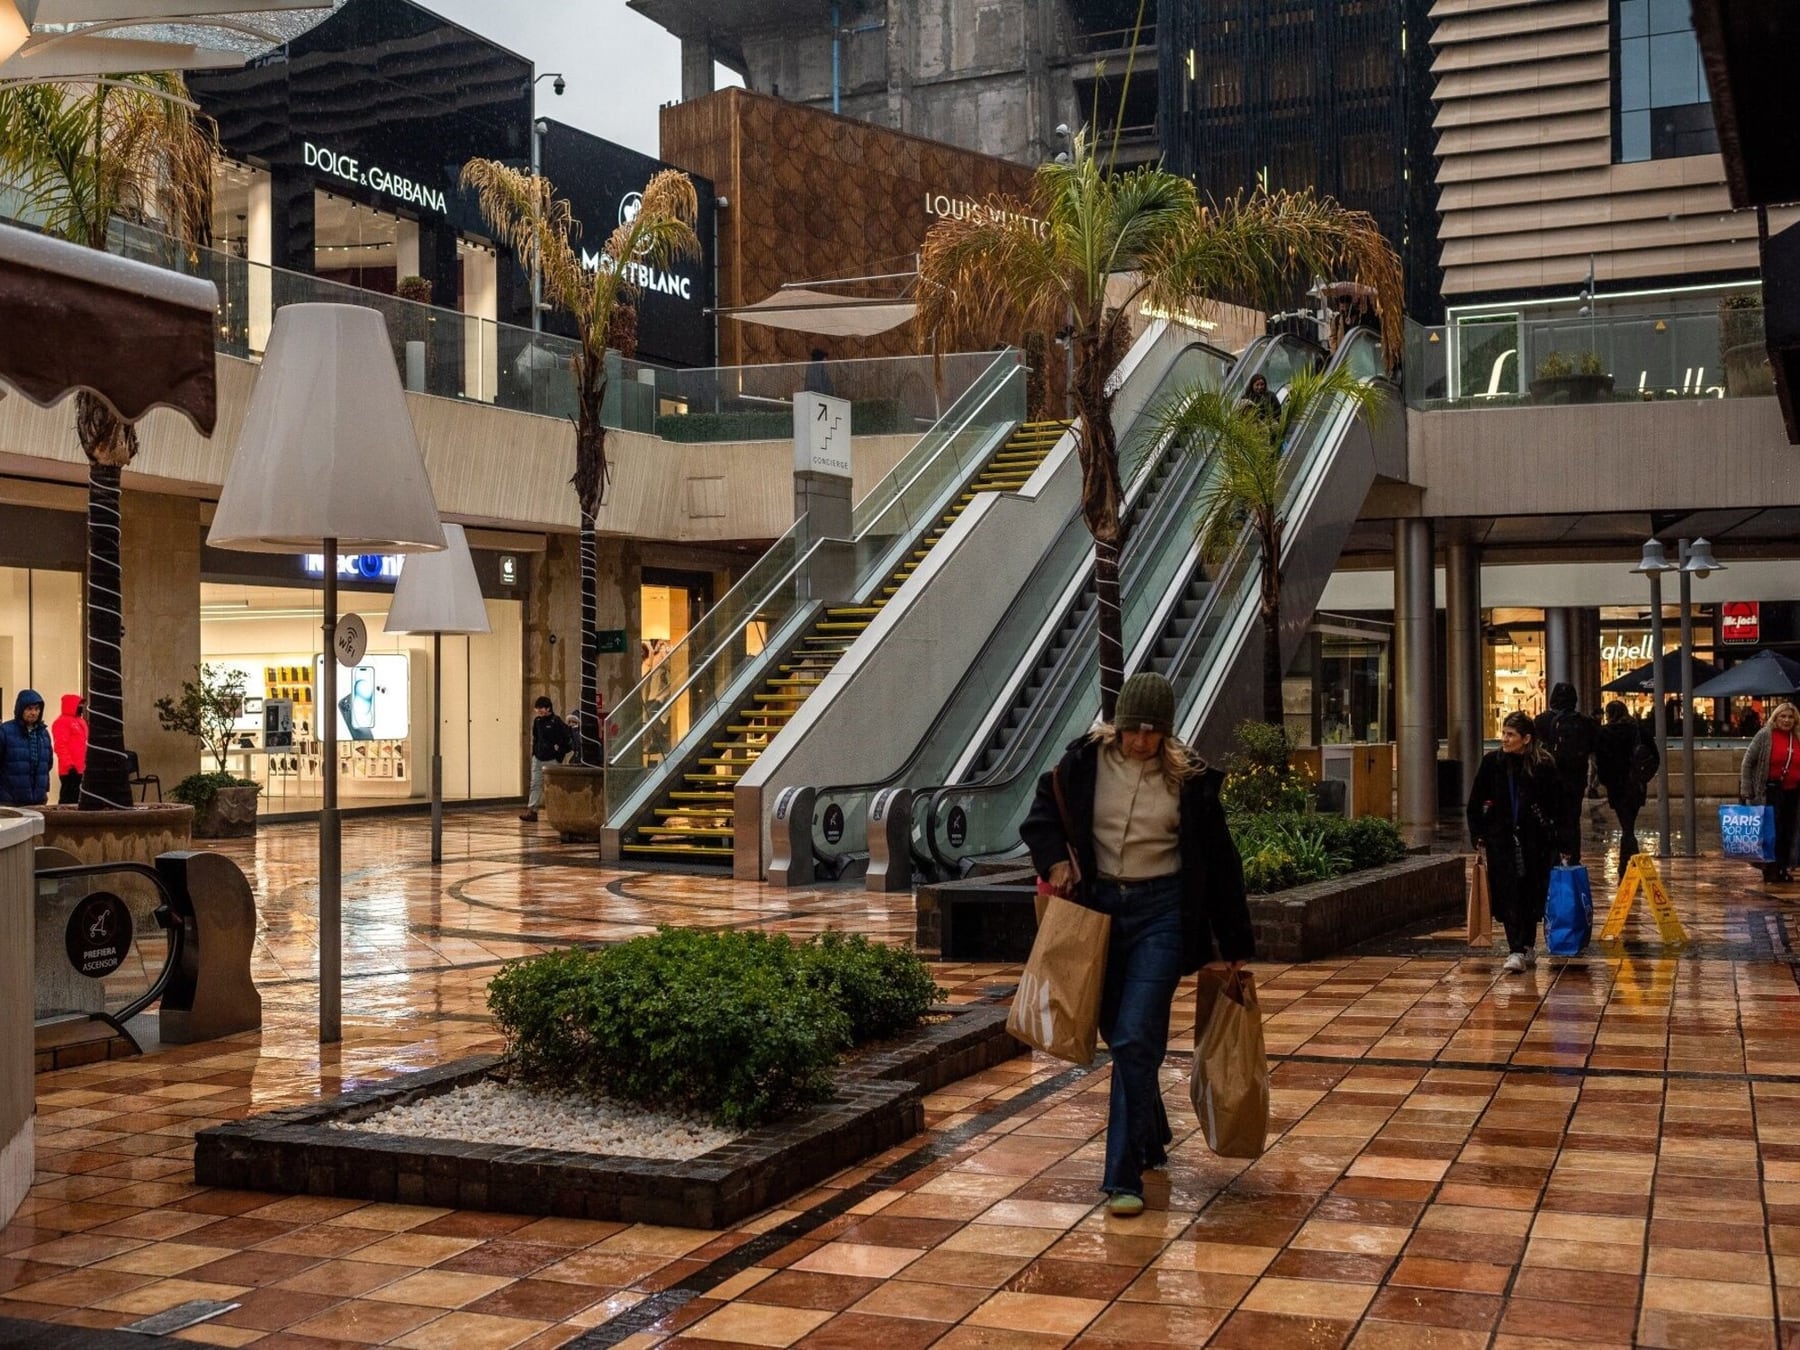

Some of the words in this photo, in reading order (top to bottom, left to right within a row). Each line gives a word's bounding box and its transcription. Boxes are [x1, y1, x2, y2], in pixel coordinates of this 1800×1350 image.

[304, 141, 359, 182] DOLCE
[360, 173, 368, 186] &
[369, 167, 447, 215] GABBANA
[925, 192, 982, 225] LOUIS
[812, 456, 849, 471] CONCIERGE
[1722, 815, 1761, 826] PARIS
[1722, 826, 1742, 835] POR
[1745, 826, 1760, 835] UN
[83, 946, 117, 959] PREFIERA
[82, 957, 118, 971] ASCENSOR
